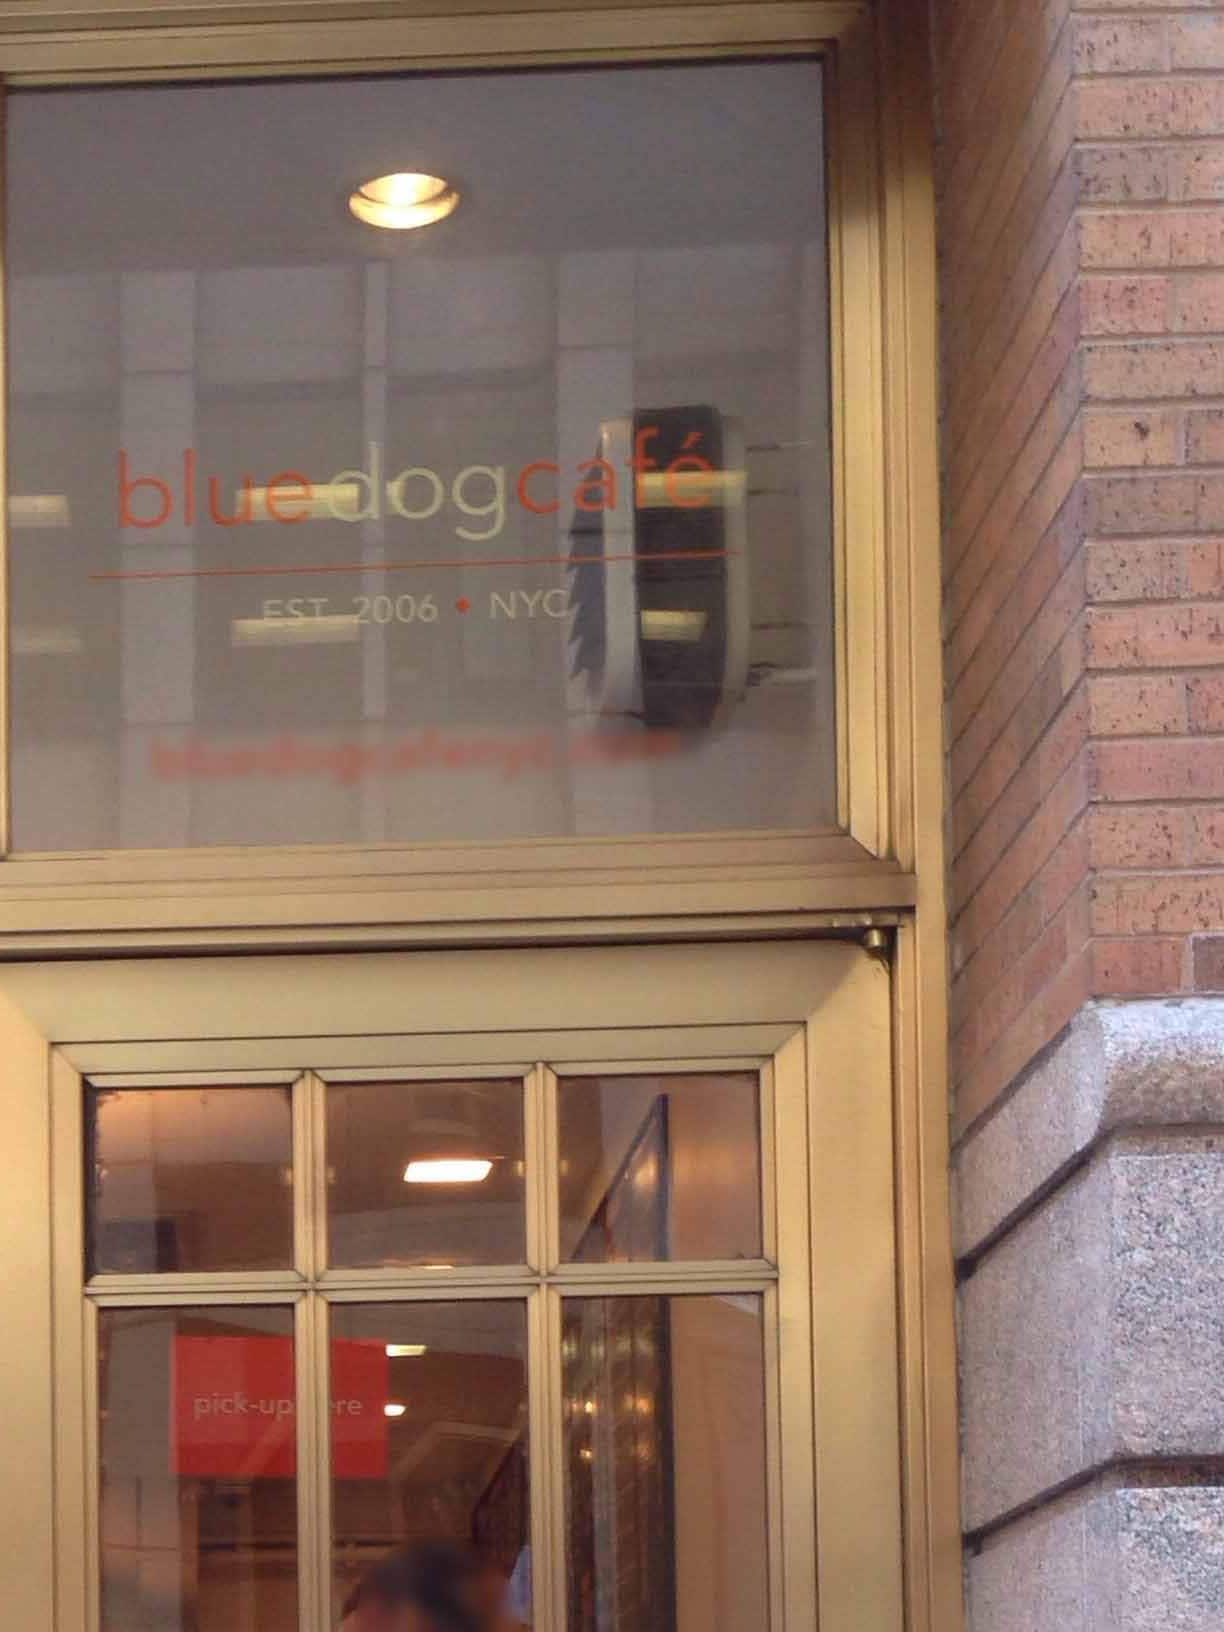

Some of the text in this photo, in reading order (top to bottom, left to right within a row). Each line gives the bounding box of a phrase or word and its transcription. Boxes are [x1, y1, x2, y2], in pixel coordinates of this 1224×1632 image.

[351, 594, 438, 625] 2006
[490, 589, 571, 619] NYC
[193, 1391, 296, 1421] pick-up
